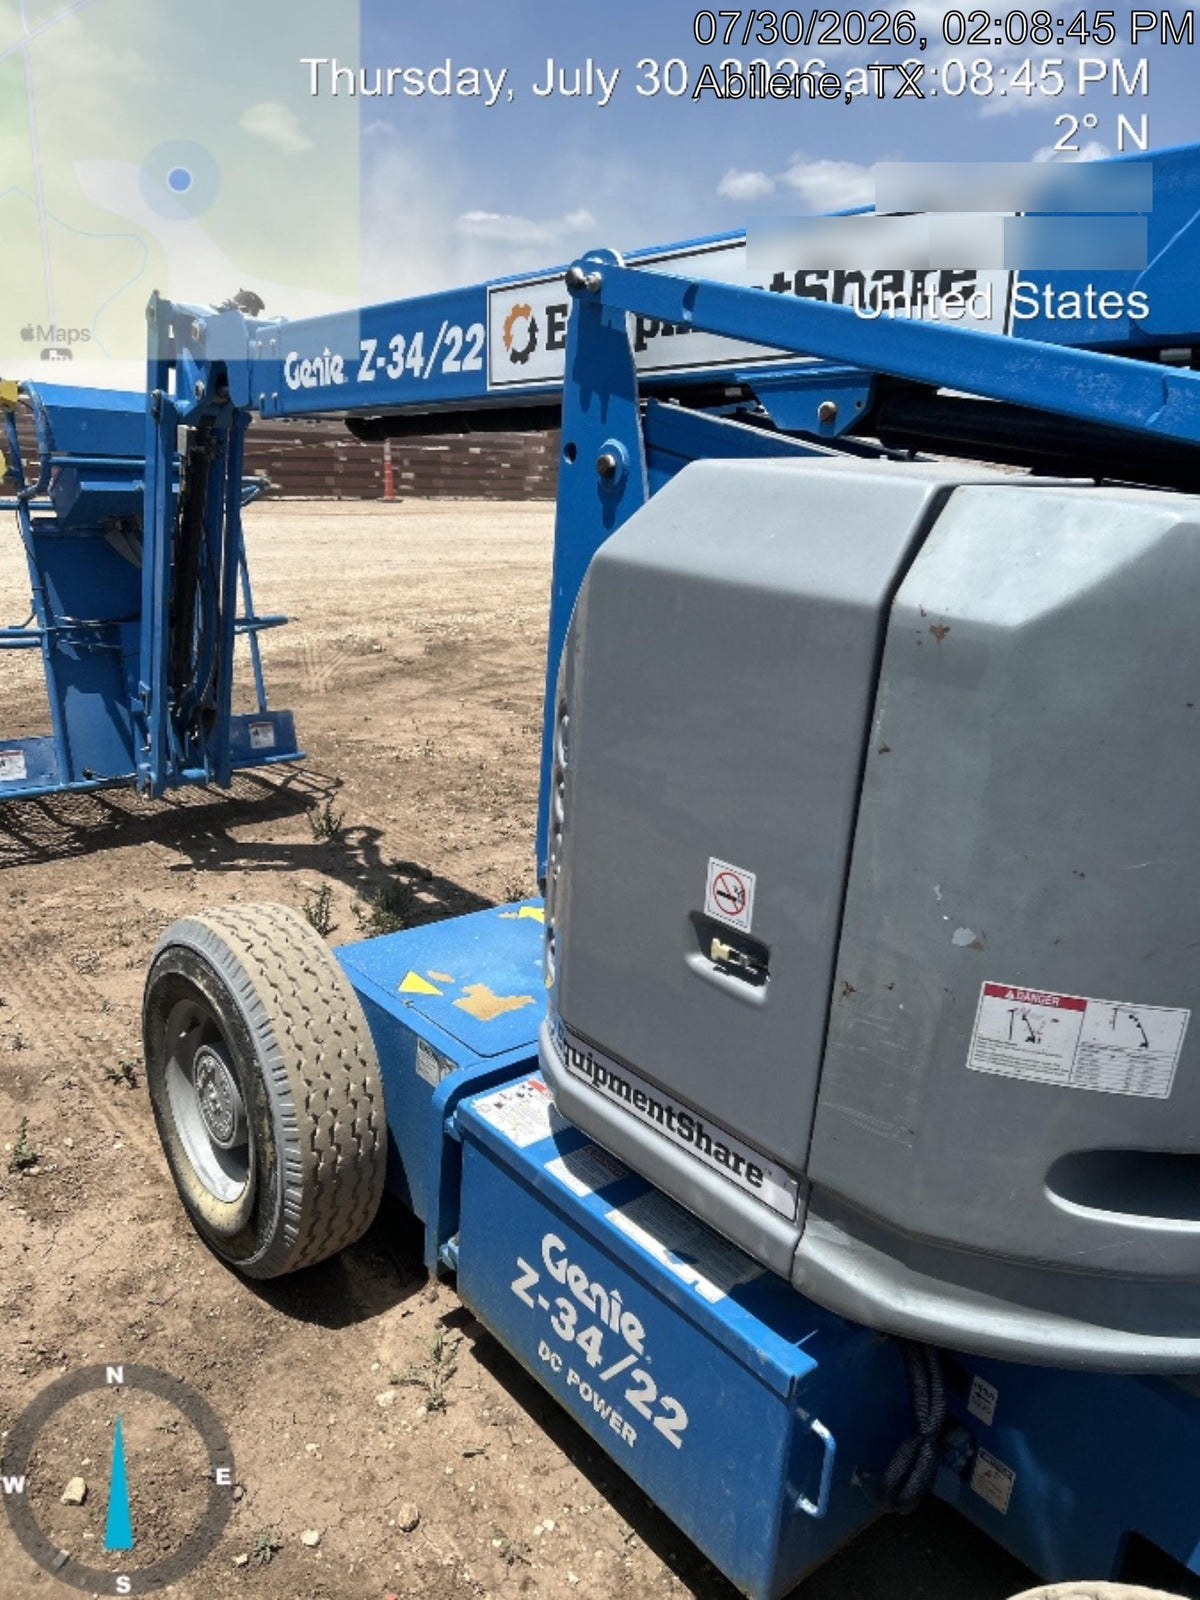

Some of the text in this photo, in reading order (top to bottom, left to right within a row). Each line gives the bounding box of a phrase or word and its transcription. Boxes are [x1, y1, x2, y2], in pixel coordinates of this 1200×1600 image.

[284, 320, 485, 390] Genie Z-34/22
[1016, 990, 1060, 1007] DANGER
[541, 1233, 646, 1356] Genie
[510, 1256, 689, 1450] Z-34/22
[537, 1339, 638, 1448] DC POWER
